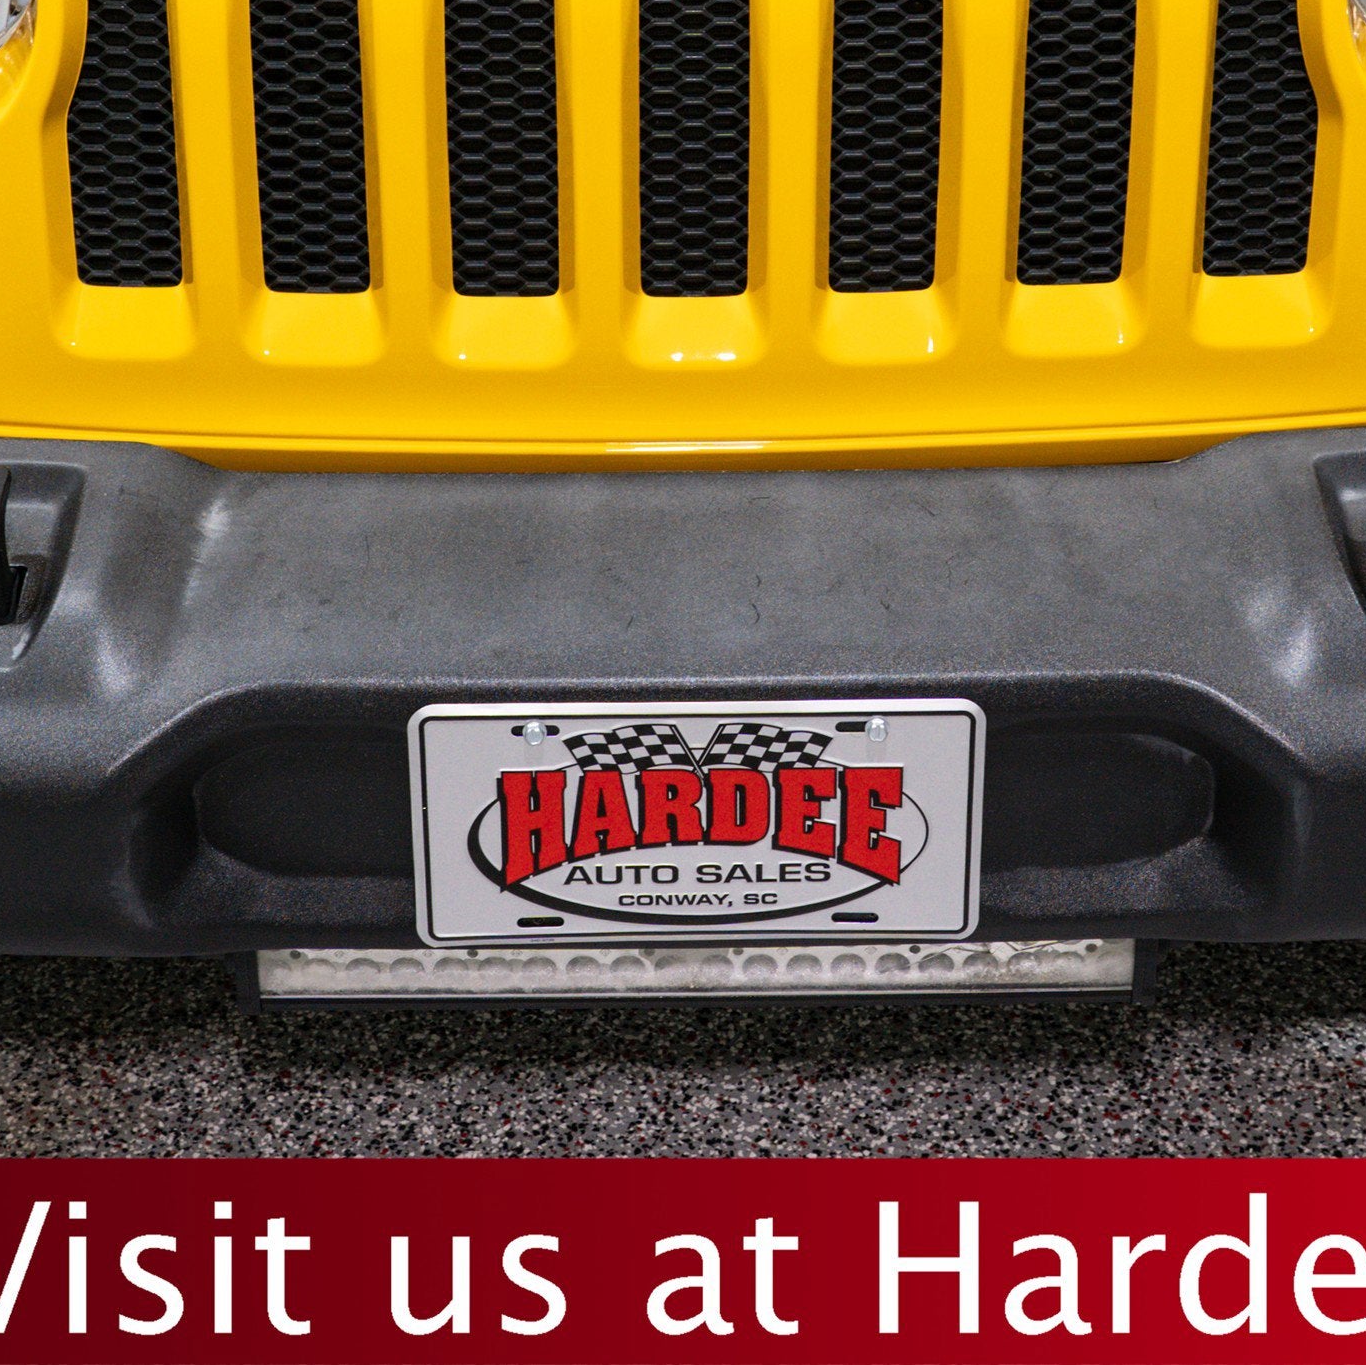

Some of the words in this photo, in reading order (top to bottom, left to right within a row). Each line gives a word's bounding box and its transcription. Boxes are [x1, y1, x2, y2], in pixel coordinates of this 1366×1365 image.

[497, 766, 904, 892] HARDEE
[563, 863, 680, 887] AUTO
[695, 861, 832, 884] SALES
[617, 892, 735, 909] CONWAY,
[742, 892, 779, 906] SC
